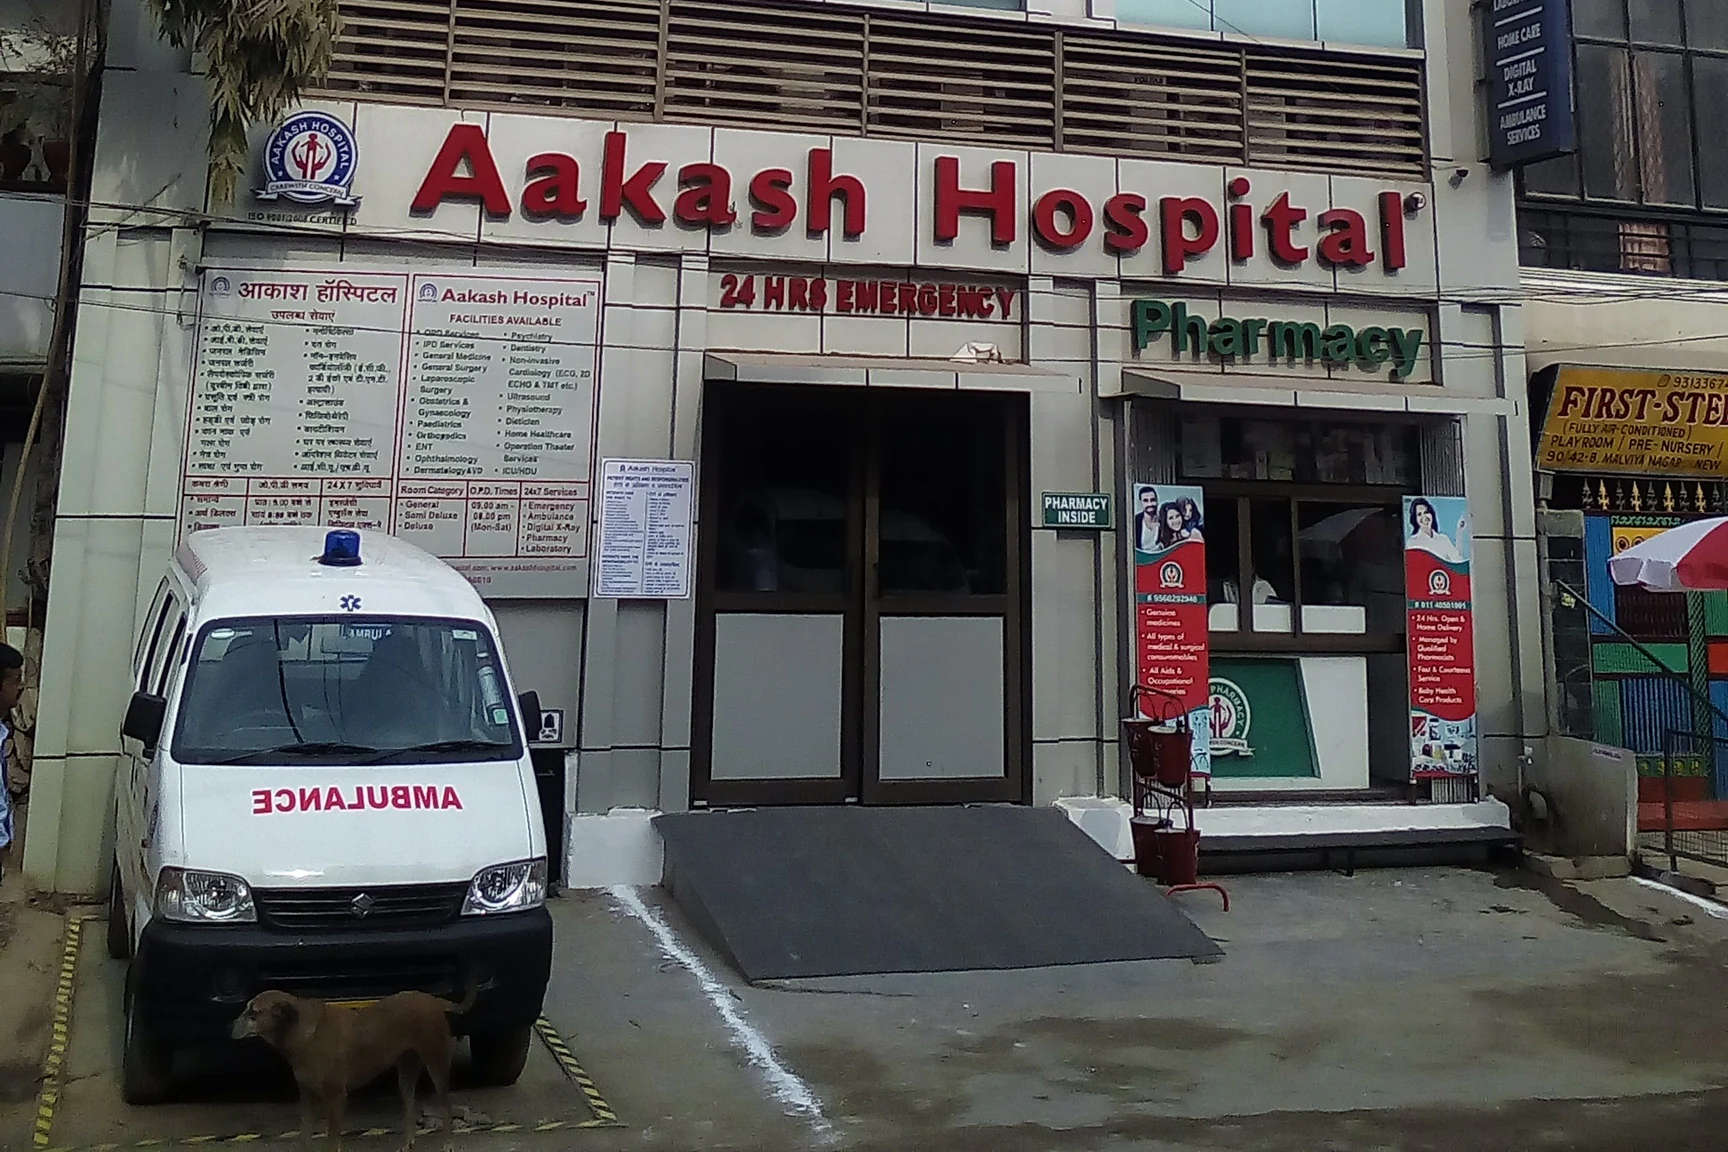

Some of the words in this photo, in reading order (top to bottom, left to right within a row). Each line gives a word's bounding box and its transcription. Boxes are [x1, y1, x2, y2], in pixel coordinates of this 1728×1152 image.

[1498, 28, 1520, 50] HOME
[1521, 23, 1541, 42] CARE
[1504, 59, 1536, 80] DIGITAL
[1508, 77, 1534, 97] X-RAY
[1500, 104, 1546, 130] AMBULANCE
[1507, 124, 1541, 145] SERVICES
[271, 122, 307, 164] AAKASH
[312, 121, 349, 169] HOSPITAL
[409, 123, 867, 240] Aakash
[932, 155, 1408, 276] Hospital
[249, 212, 264, 220] ISO
[238, 282, 308, 301] आकाश
[316, 279, 397, 304] हॉस्पिटल
[442, 288, 507, 304] Aakash
[514, 291, 587, 309] Hospital
[720, 274, 755, 308] 24
[764, 276, 827, 310] HRS
[836, 279, 1017, 319] EMERGENCY
[450, 314, 504, 324] FACILITIES
[507, 317, 562, 326] AVAILABLE
[1131, 298, 1423, 377] Pharmacy
[511, 344, 546, 353] Dentistry
[422, 352, 453, 360] General
[456, 353, 491, 361] Medicine
[455, 364, 488, 374] Surgery
[509, 368, 551, 378] Cardiology
[508, 381, 532, 389] ECHO
[1673, 376, 1728, 389] 9313367
[420, 386, 453, 396] Surgery
[419, 397, 461, 406] Obstetrics
[507, 393, 551, 401] Ultrasound
[506, 405, 563, 415] Physiotherapy
[417, 420, 462, 428] Paediatrics
[530, 430, 572, 438] Healthcare
[1563, 421, 1599, 435] (FULLY
[1601, 424, 1693, 441] AIR-CONDITIONED)
[416, 443, 433, 451] ENT
[504, 442, 543, 451] Operation
[1551, 437, 1614, 449] PLAYROOM
[503, 455, 539, 463] Services
[1602, 453, 1645, 466] MALVIYA
[1696, 458, 1722, 470] NEW
[327, 482, 338, 490] 24
[401, 486, 427, 494] Room
[428, 487, 464, 496] Category
[495, 487, 518, 495] Times
[543, 488, 577, 496] Services
[529, 502, 575, 511] Emergency
[1045, 497, 1108, 510] PHARMACY
[405, 512, 426, 520] Semi
[428, 512, 458, 520] Deluxe
[528, 513, 574, 521] Ambulance
[1057, 510, 1096, 524] INSIDE
[404, 522, 433, 530] Deluxe
[471, 523, 512, 532] (Mon-Sat)
[527, 523, 554, 532] Digital
[556, 524, 580, 533] X-Ray
[526, 534, 568, 543] Pharmacy
[526, 545, 571, 554] Laboratory
[1441, 615, 1459, 623] Open
[1437, 624, 1462, 632] Delivery
[1158, 633, 1175, 641] types
[1450, 636, 1457, 644] by
[1180, 643, 1205, 652] surgical
[1148, 677, 1193, 685] Occupational
[1419, 687, 1434, 695] Baby
[1210, 685, 1245, 728] PHARMACY
